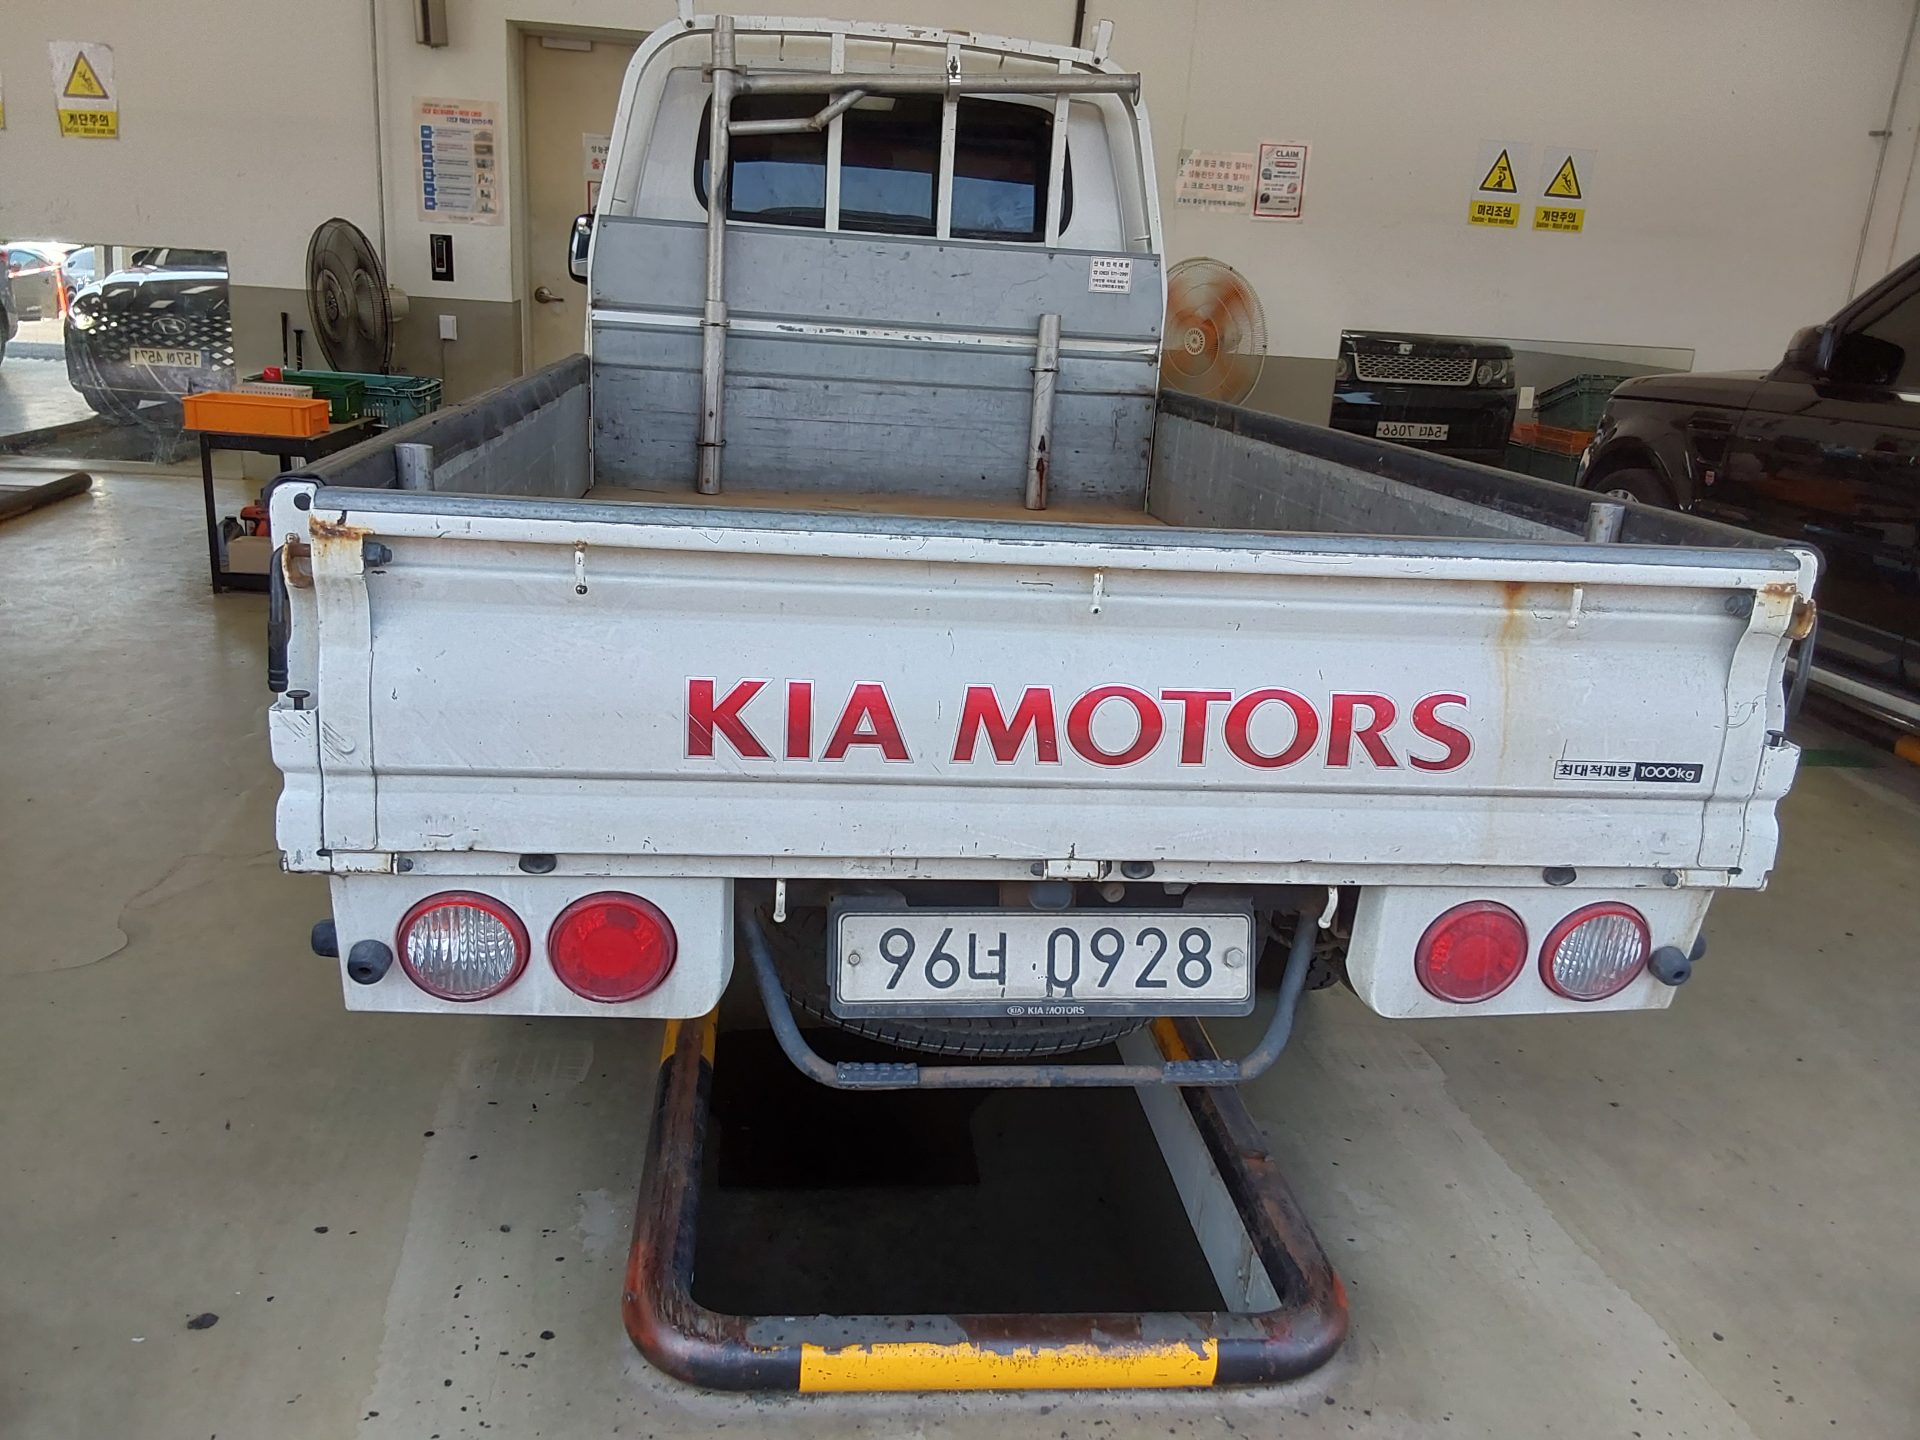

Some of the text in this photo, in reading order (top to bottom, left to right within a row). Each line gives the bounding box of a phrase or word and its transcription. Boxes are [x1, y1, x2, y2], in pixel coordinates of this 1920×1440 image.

[67, 113, 109, 127] 계단주의
[1276, 150, 1300, 158] CLAIM
[1191, 183, 1224, 192] 크로스체크
[1477, 204, 1512, 218] 머리조심
[1542, 210, 1576, 224] 계단주의
[683, 675, 1476, 773] KIA MOTORS
[1558, 764, 1696, 782] 최대적재량 1000kg
[878, 926, 1213, 990] 96너 0928
[1027, 1006, 1044, 1015] KIA
[1045, 1006, 1085, 1016] MOTORS
